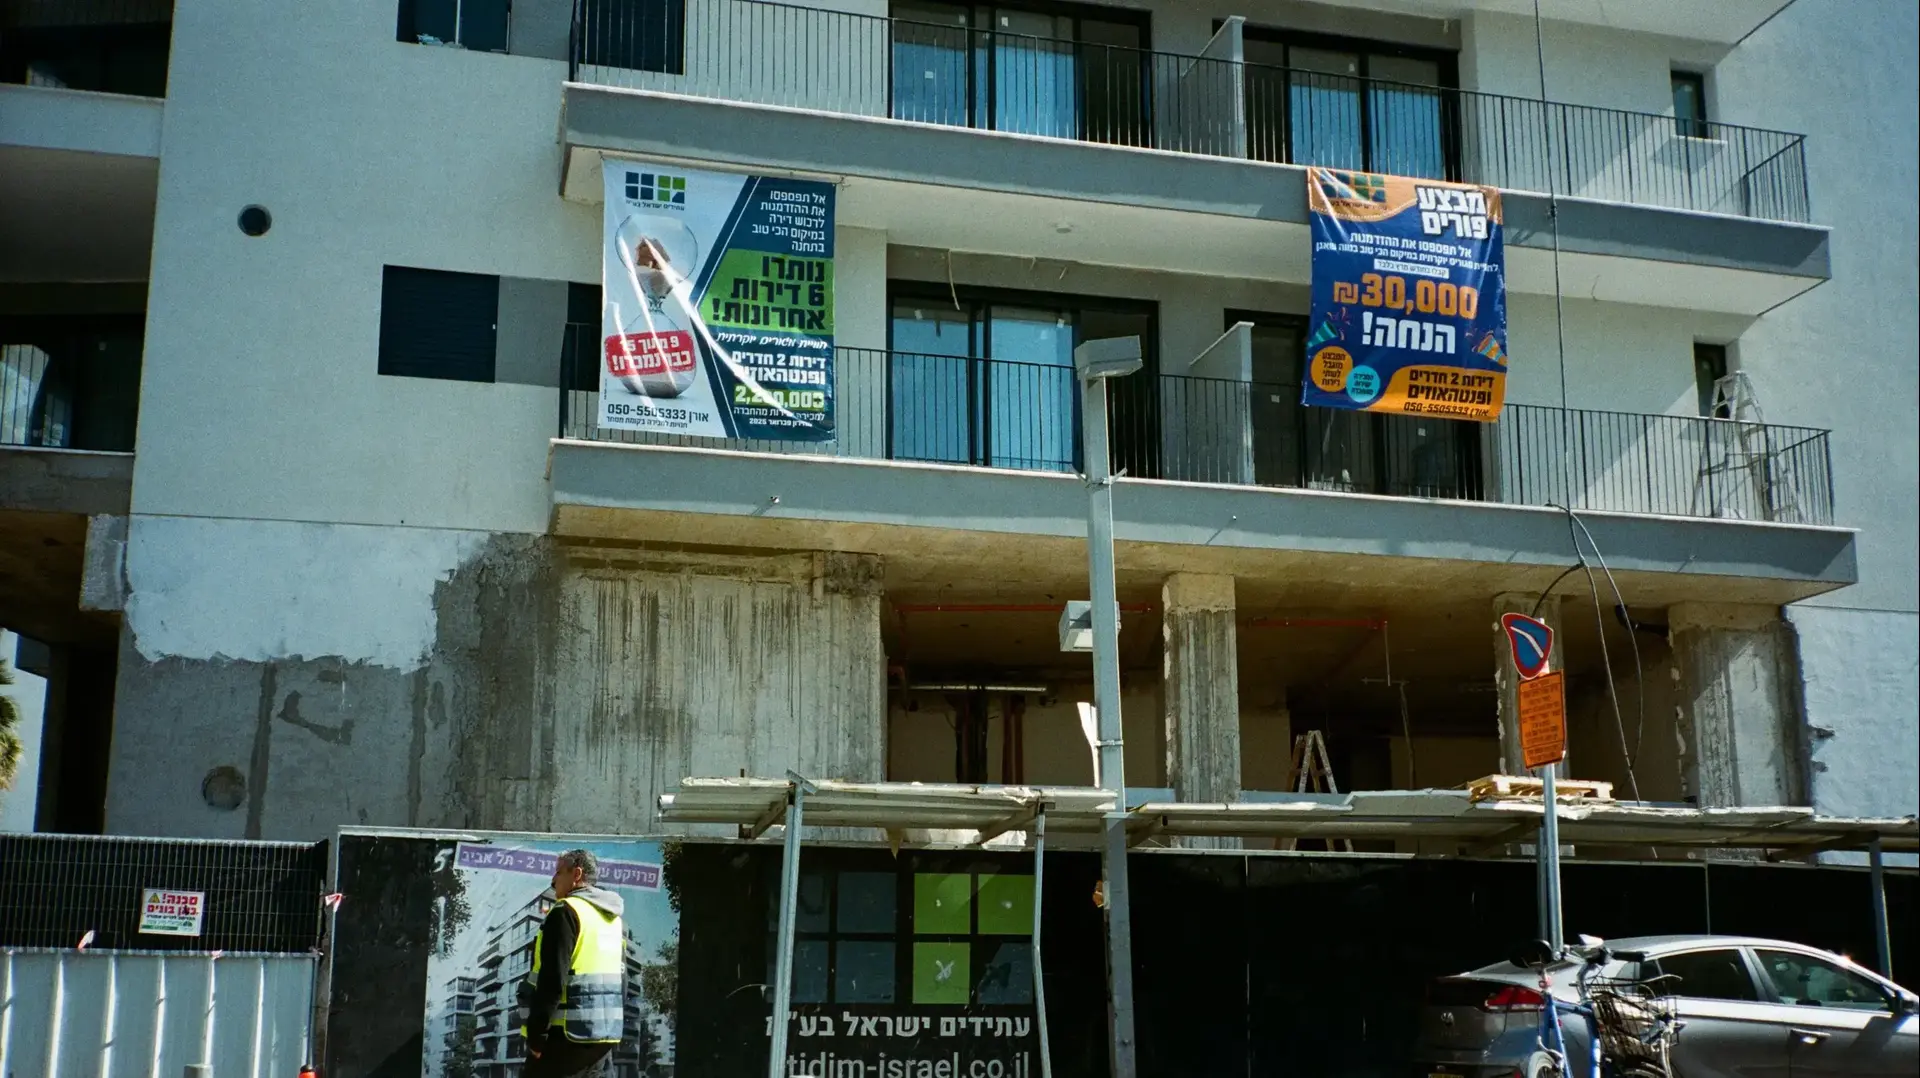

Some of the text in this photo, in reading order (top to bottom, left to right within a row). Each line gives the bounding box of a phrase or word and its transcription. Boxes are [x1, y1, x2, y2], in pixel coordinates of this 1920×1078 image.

[770, 190, 826, 204] אל תפספסו
[1416, 187, 1487, 214] מבצע
[760, 202, 825, 216] את ההזדמנות
[769, 213, 825, 228] לרכוש דירה
[1421, 211, 1488, 240] פורים
[752, 223, 825, 241] במיקום הכי טוב
[791, 240, 825, 253] בתחנה
[1350, 233, 1472, 258] אל תפספסו את ההזדמנות
[1359, 245, 1374, 254] טוב
[1375, 247, 1389, 257] הכי
[1390, 248, 1418, 261] במיקום
[1419, 253, 1448, 266] יוקרתית
[762, 256, 825, 282] נותרו
[731, 278, 825, 307] 6 דירות
[713, 298, 825, 331] אחרונות!
[716, 332, 757, 346] יוקרתית
[1362, 311, 1456, 354] הנחה!
[670, 336, 679, 348] 9
[731, 350, 826, 369] דירות 2 חדרים
[1409, 368, 1495, 389] דירות 2 חדרים
[1407, 384, 1492, 406] ופנטהאוזים
[689, 411, 709, 423] אורן
[734, 407, 768, 416] מהחברה
[461, 850, 494, 865] אביב
[496, 850, 514, 866] תל
[526, 855, 535, 869] 2
[613, 867, 657, 883] פרויקט
[162, 893, 198, 905] סכנה!
[147, 904, 175, 913] בונים
[843, 1011, 931, 1038] ישראל
[939, 1016, 1030, 1037] עתידים
[786, 1051, 1029, 1078] tidim-israel.co.il
